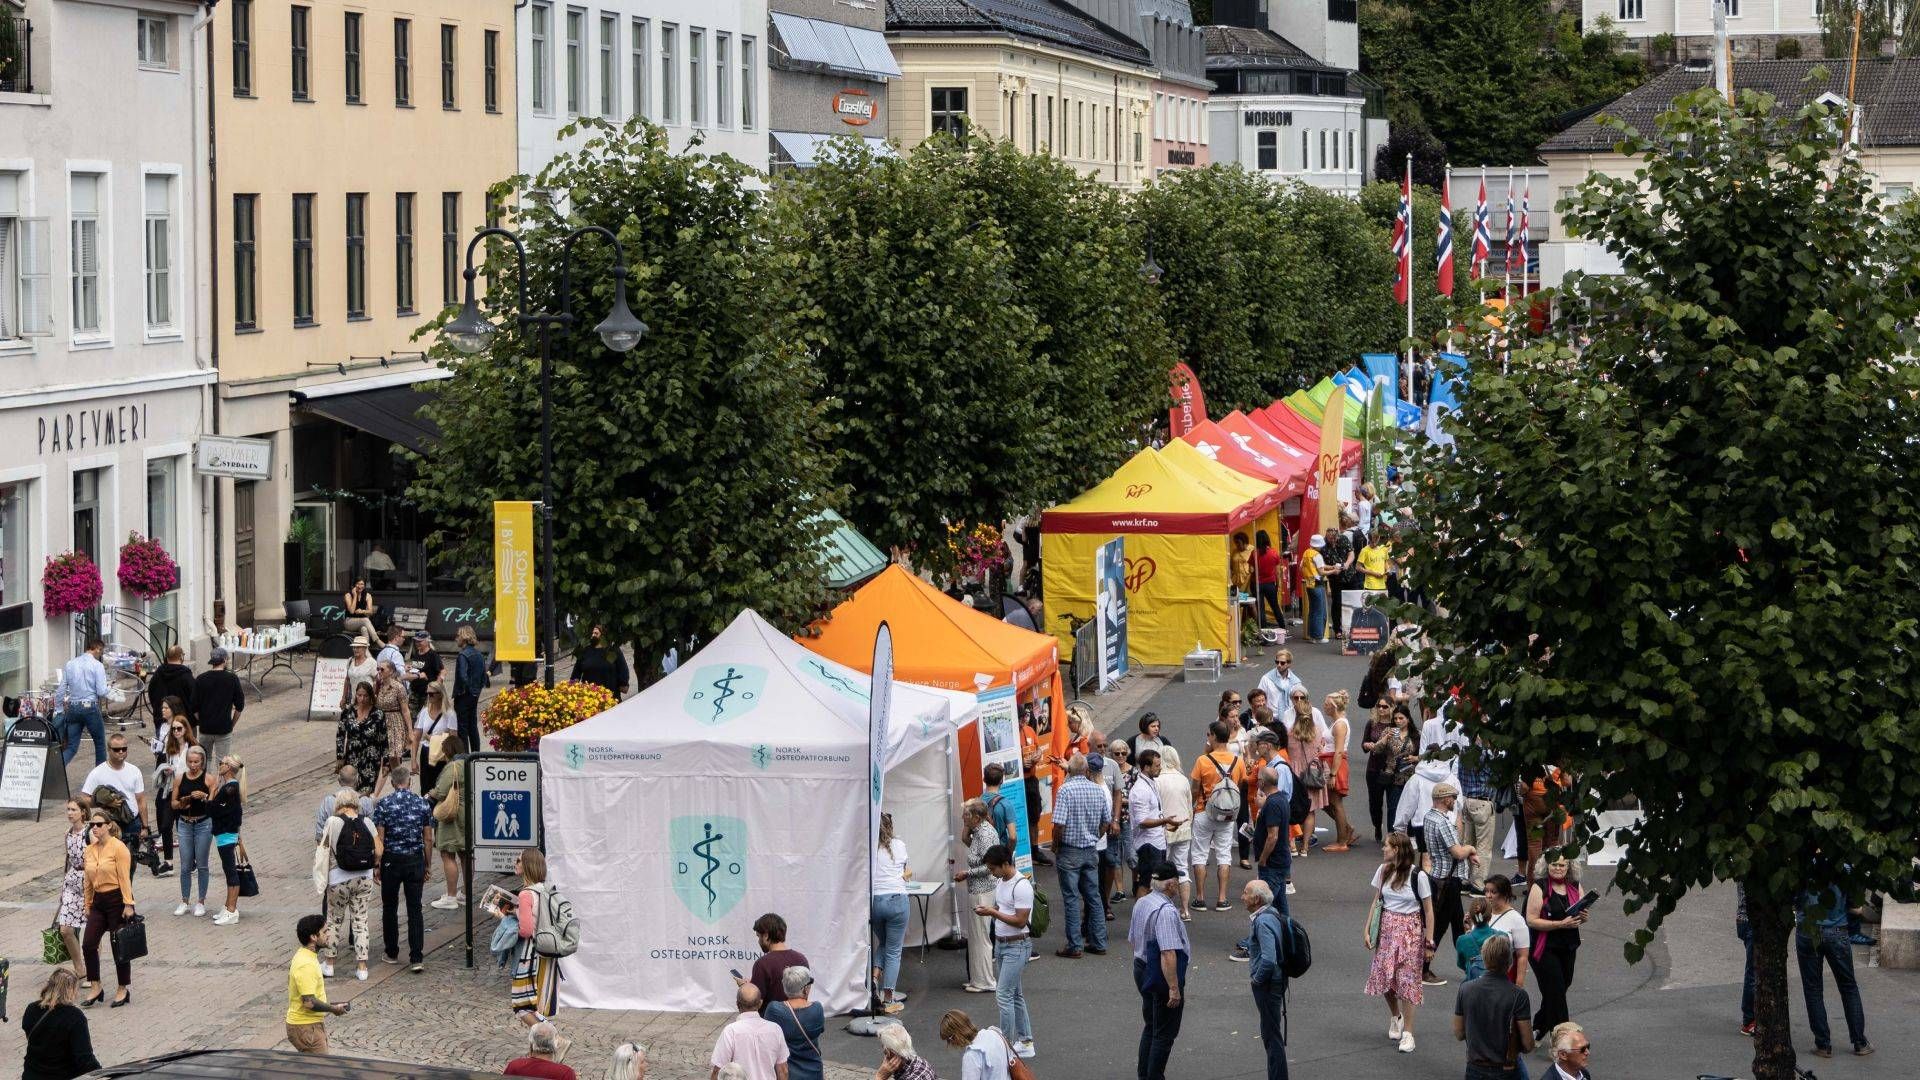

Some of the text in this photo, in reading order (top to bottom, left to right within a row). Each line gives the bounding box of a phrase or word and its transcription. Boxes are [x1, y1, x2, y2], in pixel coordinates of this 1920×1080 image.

[38, 403, 147, 455] PARFYMERI
[1125, 484, 1153, 500] krf
[1111, 517, 1159, 528] www.krf.no
[932, 679, 960, 689] Norge
[775, 746, 801, 754] NORSK
[588, 753, 662, 761] OSTEOPATFORBUND
[775, 754, 850, 763] OSTEOPATFORBUND
[485, 765, 528, 782] Sone
[489, 792, 523, 803] Gågate
[678, 861, 741, 875] D O
[687, 935, 730, 946] NORSK
[650, 949, 762, 961] OSTEOPATFORBUN
